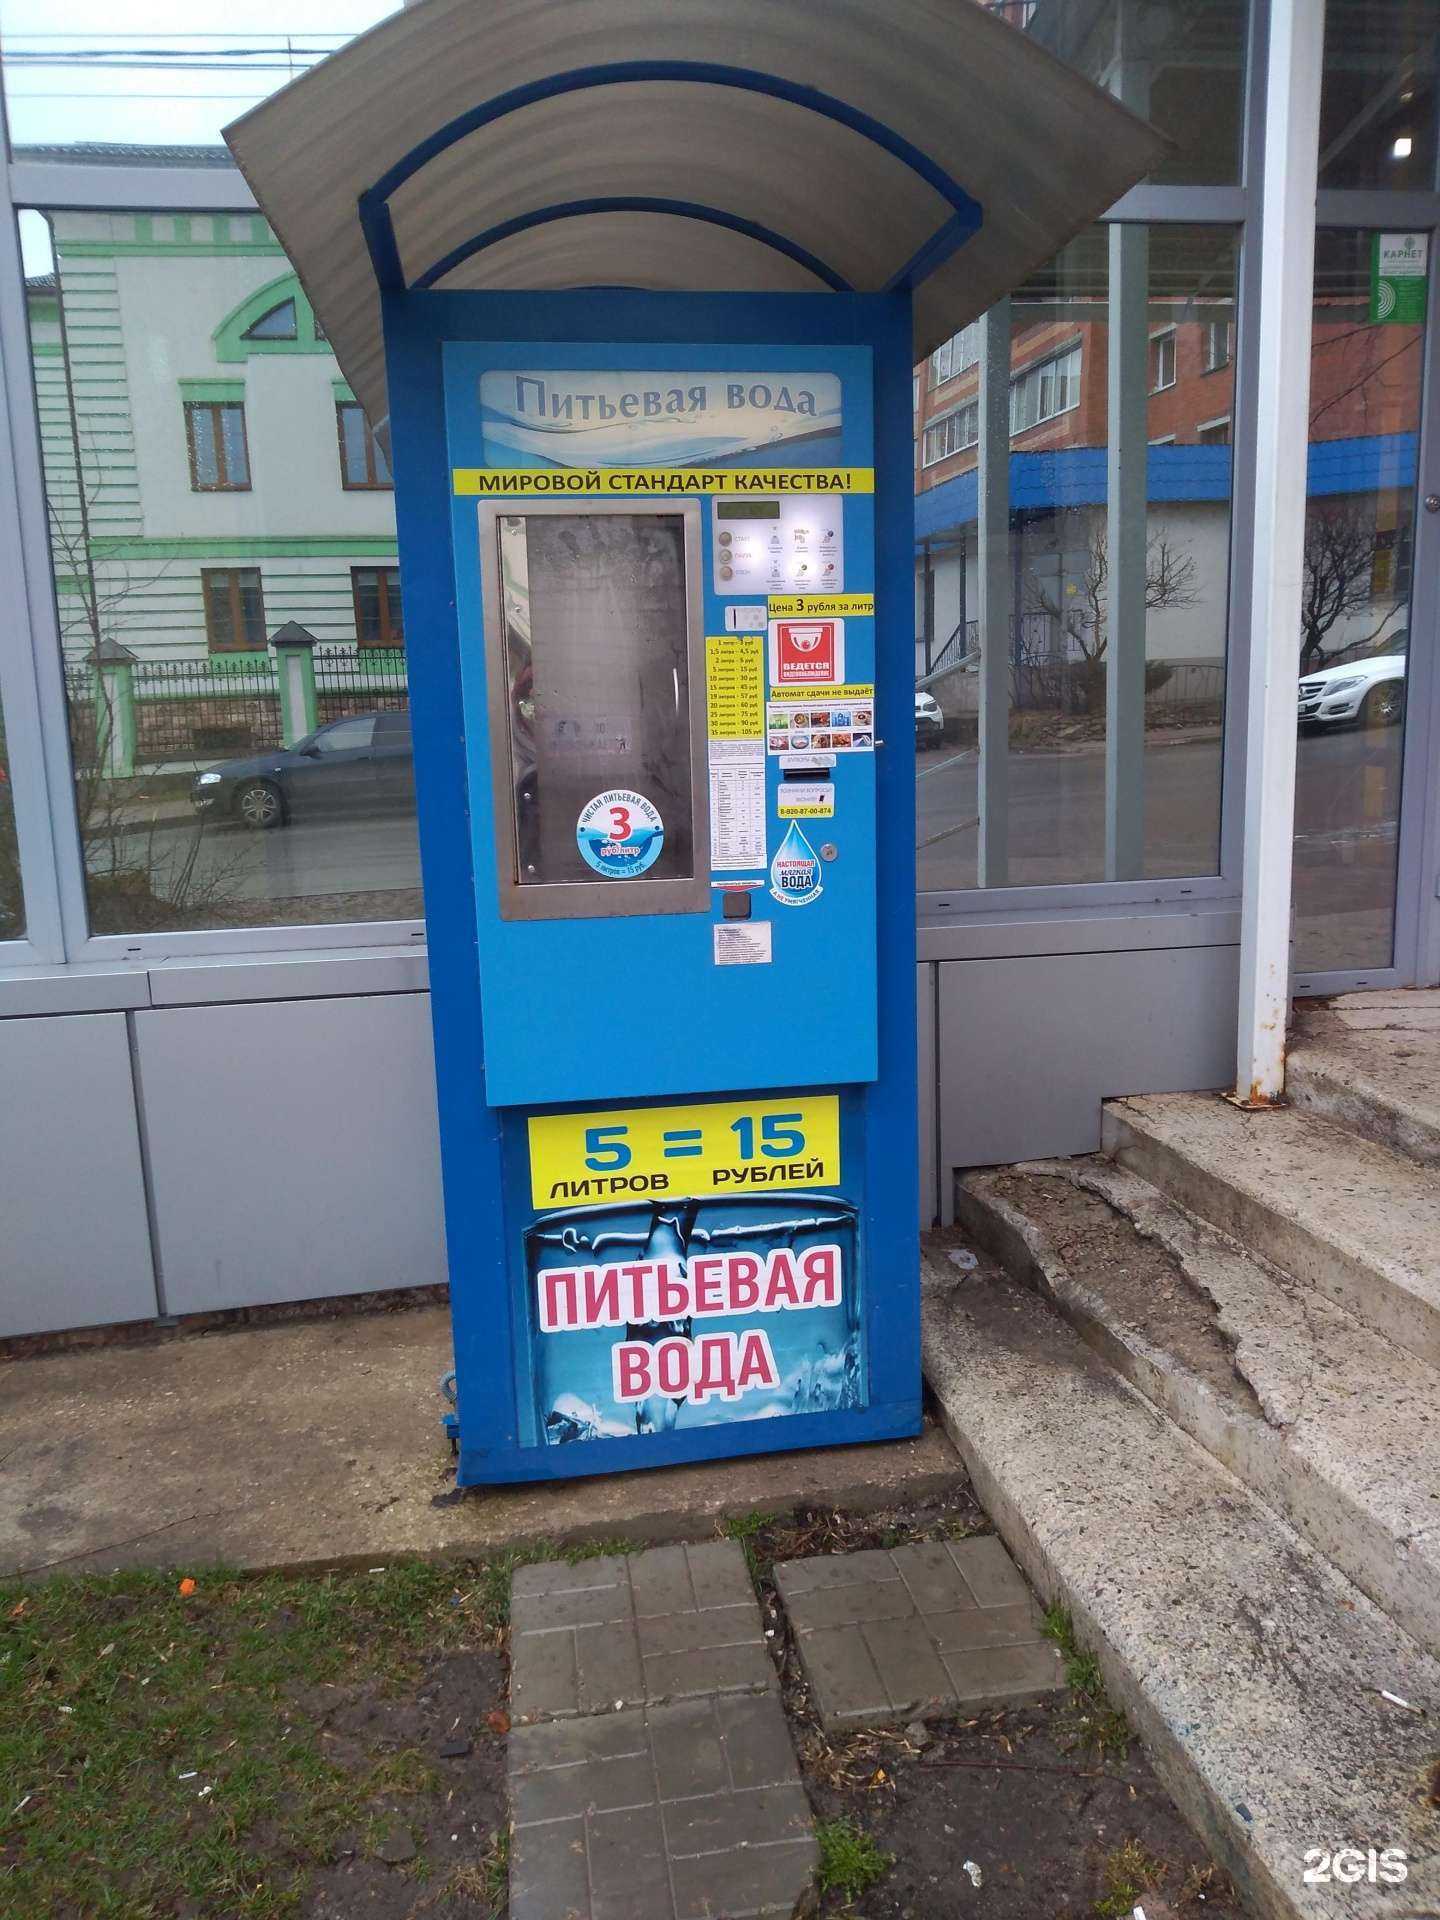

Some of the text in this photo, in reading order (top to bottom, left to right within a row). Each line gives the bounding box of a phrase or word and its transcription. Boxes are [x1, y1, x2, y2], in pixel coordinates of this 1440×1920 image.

[515, 375, 817, 420] Питьевая вода
[479, 470, 852, 492] МИРОВОЙ СТАНДАРТ КАЧЕСТВА!
[769, 603, 793, 613] Цена
[796, 599, 804, 612] 3
[807, 602, 836, 613] рубля
[851, 603, 874, 612] литр
[783, 662, 830, 671] ВЕДЕТСЯ
[771, 690, 804, 698] Автомат
[806, 690, 830, 698] сдачи
[844, 688, 873, 697] выдаёт
[582, 793, 658, 823] ЧИСТАЯ ПИТЬЕВАЯ ВОДА
[609, 807, 632, 840] 3
[776, 860, 815, 868] НАСТОЯЩАЯ
[781, 876, 812, 888] ВОДА
[584, 1112, 806, 1171] 5 = 15
[549, 1157, 824, 1199] ЛИТРОВ РУБЛЕЙ
[543, 1249, 836, 1328] ПИТЬЕВАЯ
[617, 1334, 774, 1400] ВОДА
